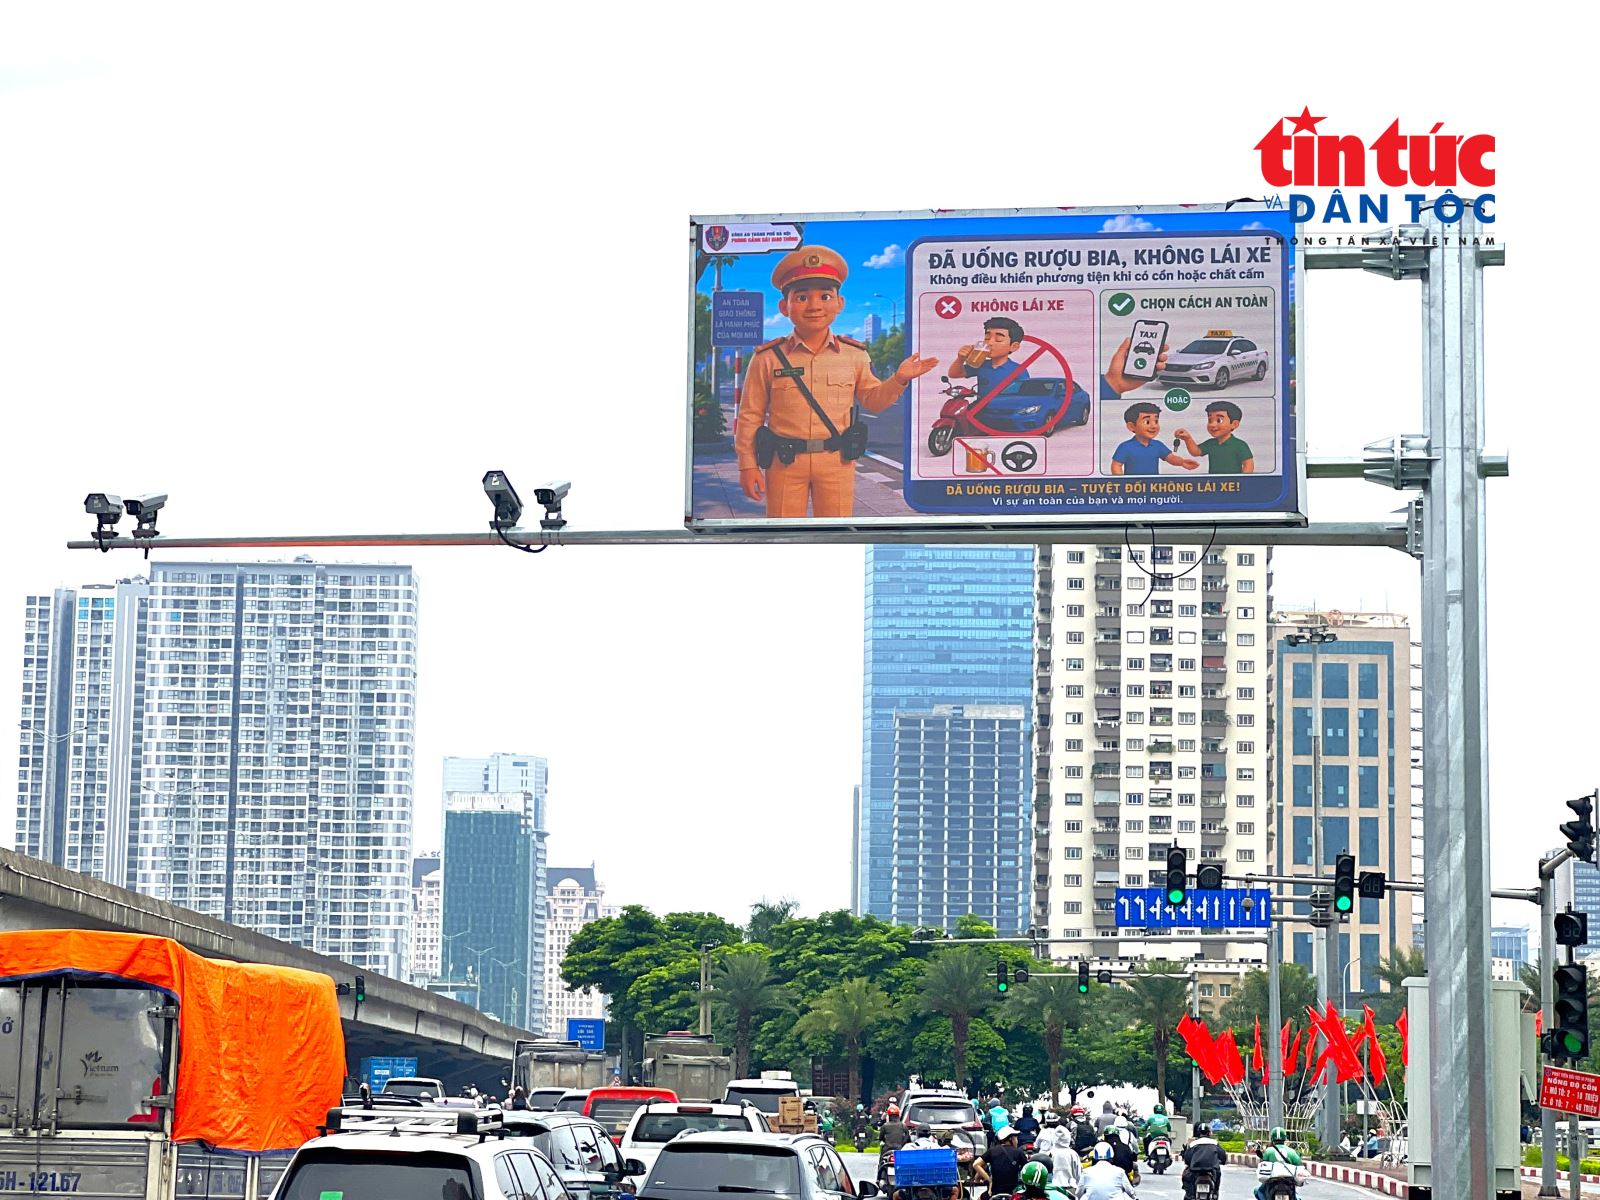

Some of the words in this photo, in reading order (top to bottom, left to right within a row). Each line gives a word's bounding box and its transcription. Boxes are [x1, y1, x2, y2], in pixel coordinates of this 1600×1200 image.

[928, 249, 956, 269] ĐÃ
[962, 246, 1018, 268] UỐNG
[1024, 249, 1082, 271] RƯỢU
[1088, 250, 1126, 268] BIA,
[1134, 245, 1204, 265] KHÔNG
[1210, 244, 1240, 263] LÁI
[1246, 247, 1271, 263] XE
[930, 274, 968, 286] Không
[971, 272, 997, 284] điều
[1000, 272, 1033, 284] khiển
[1036, 272, 1084, 285] phương
[1087, 272, 1110, 284] tiện
[1113, 270, 1132, 282] khi
[1135, 270, 1148, 281] có
[1152, 269, 1174, 281] cồn
[1177, 270, 1206, 282] hoặc
[1210, 268, 1236, 280] chất
[1239, 268, 1264, 279] cấm
[971, 298, 1018, 312] KHÔNG
[1022, 298, 1043, 311] LÁI
[1047, 300, 1064, 310] XE
[1140, 298, 1175, 311] CHỌN
[1178, 295, 1212, 308] CÁCH
[1215, 297, 1232, 308] AN
[1235, 294, 1268, 307] TOÀN
[1140, 331, 1158, 339] TAXI
[1166, 395, 1188, 405] HOẶC
[946, 484, 962, 495] ĐÃ
[966, 482, 1001, 495] UỐNG
[1005, 484, 1040, 496] RƯỢU
[1044, 484, 1065, 494] BIA
[1082, 482, 1120, 495] TUYỆT
[1125, 480, 1146, 492] ĐỐI
[1150, 481, 1193, 492] KHÔNG
[1198, 480, 1216, 492] LÁI
[1220, 482, 1240, 492] XE!
[992, 497, 1003, 506] Vì
[1006, 498, 1020, 507] sự
[1039, 496, 1062, 505] toàn
[1066, 496, 1085, 504] của
[1088, 496, 1108, 506] bạn
[1127, 496, 1146, 506] mọi
[1150, 495, 1183, 505] người.
